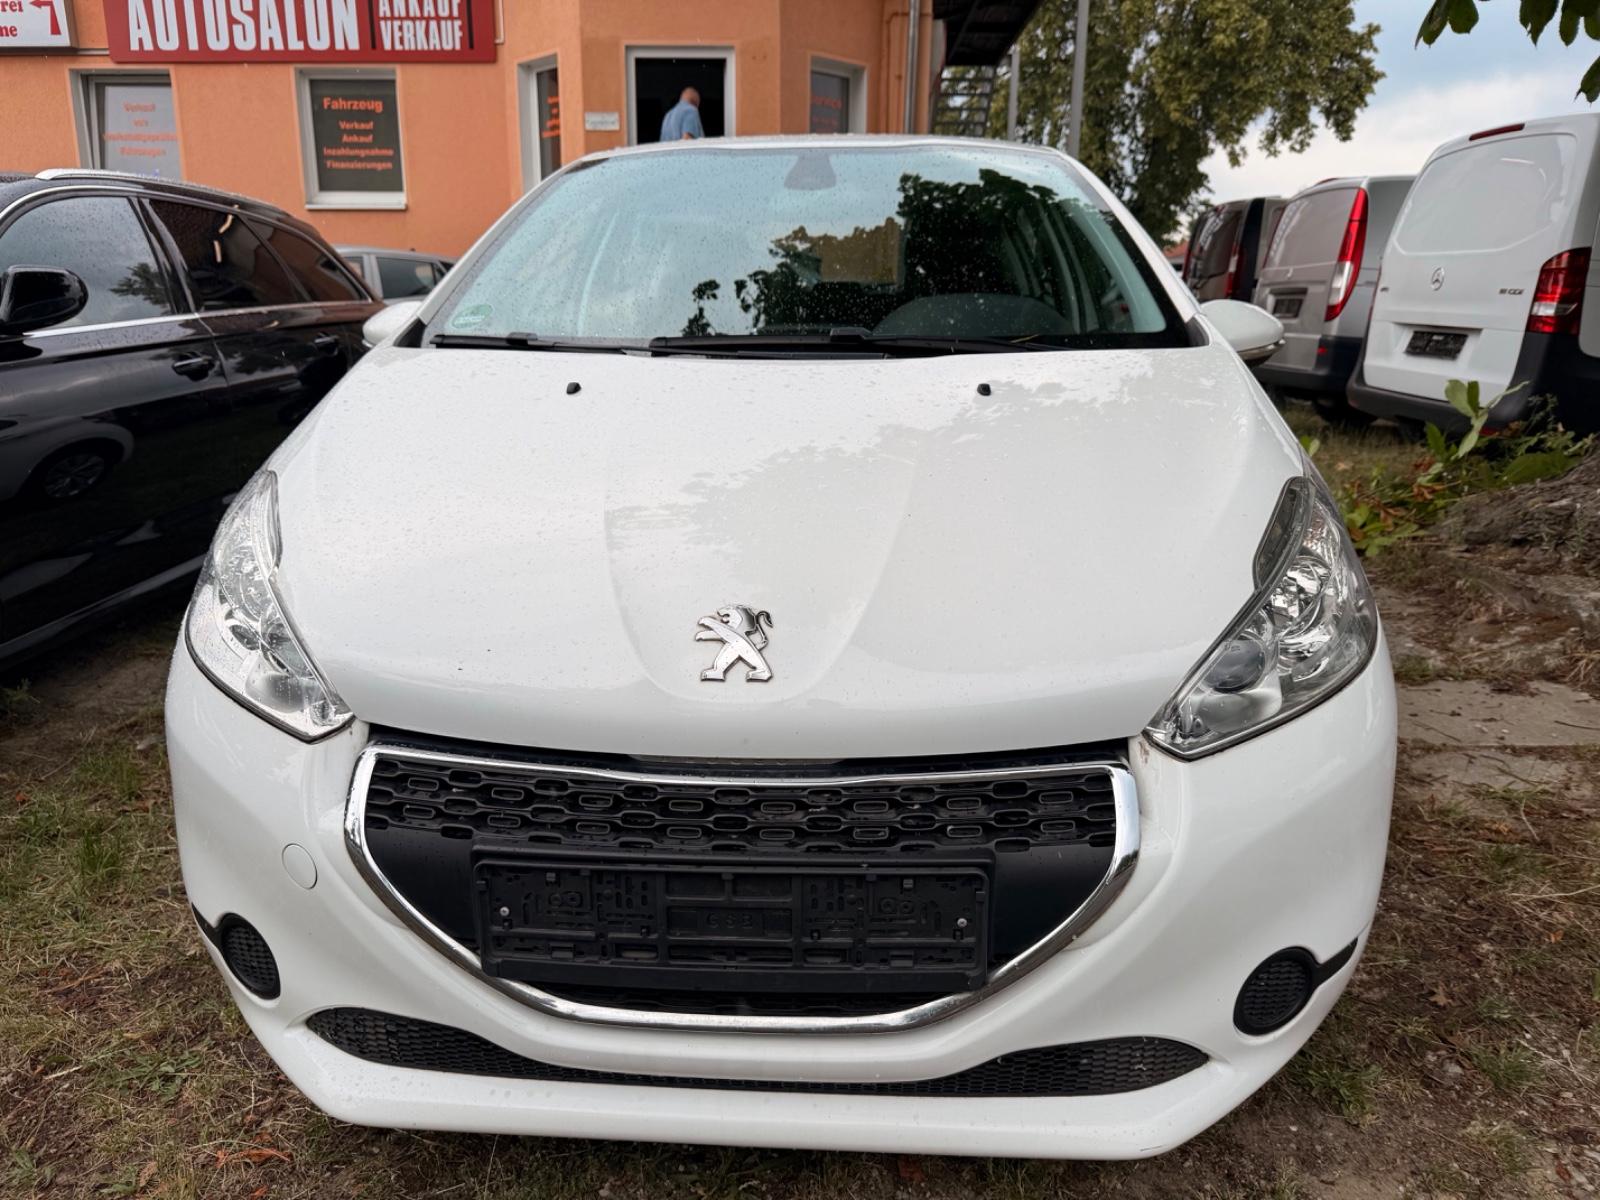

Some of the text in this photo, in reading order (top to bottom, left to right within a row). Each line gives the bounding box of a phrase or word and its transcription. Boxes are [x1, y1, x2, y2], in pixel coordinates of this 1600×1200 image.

[379, 0, 461, 17] ANKAUF
[128, 0, 361, 51] AUTOSALON
[379, 20, 463, 51] VERKAUF
[323, 97, 383, 113] Fahrzeug
[339, 121, 374, 130] Verkauf
[342, 135, 373, 143] Ankauf
[326, 160, 393, 171] Finanzierungen
